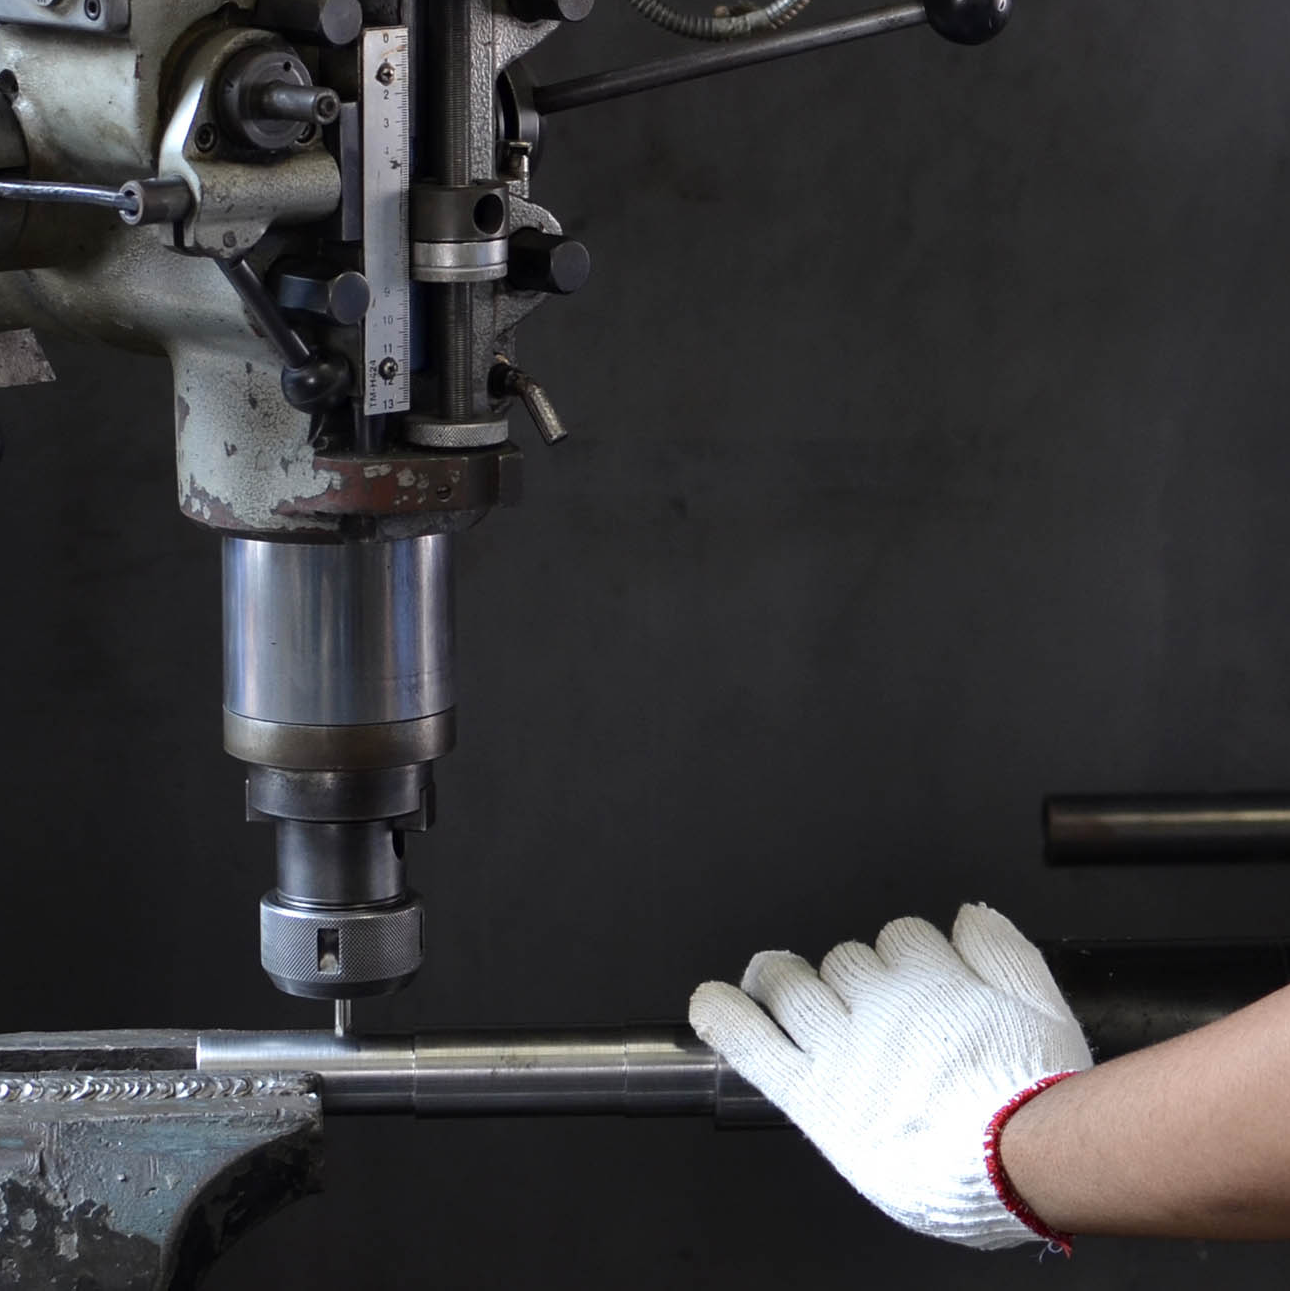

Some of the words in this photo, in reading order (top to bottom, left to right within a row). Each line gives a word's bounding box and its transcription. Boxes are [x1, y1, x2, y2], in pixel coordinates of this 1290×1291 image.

[383, 32, 389, 44] 0
[383, 90, 390, 100] 2
[383, 117, 390, 129] 3
[382, 315, 394, 326] 10
[383, 343, 393, 354] 11
[382, 398, 395, 410] 13
